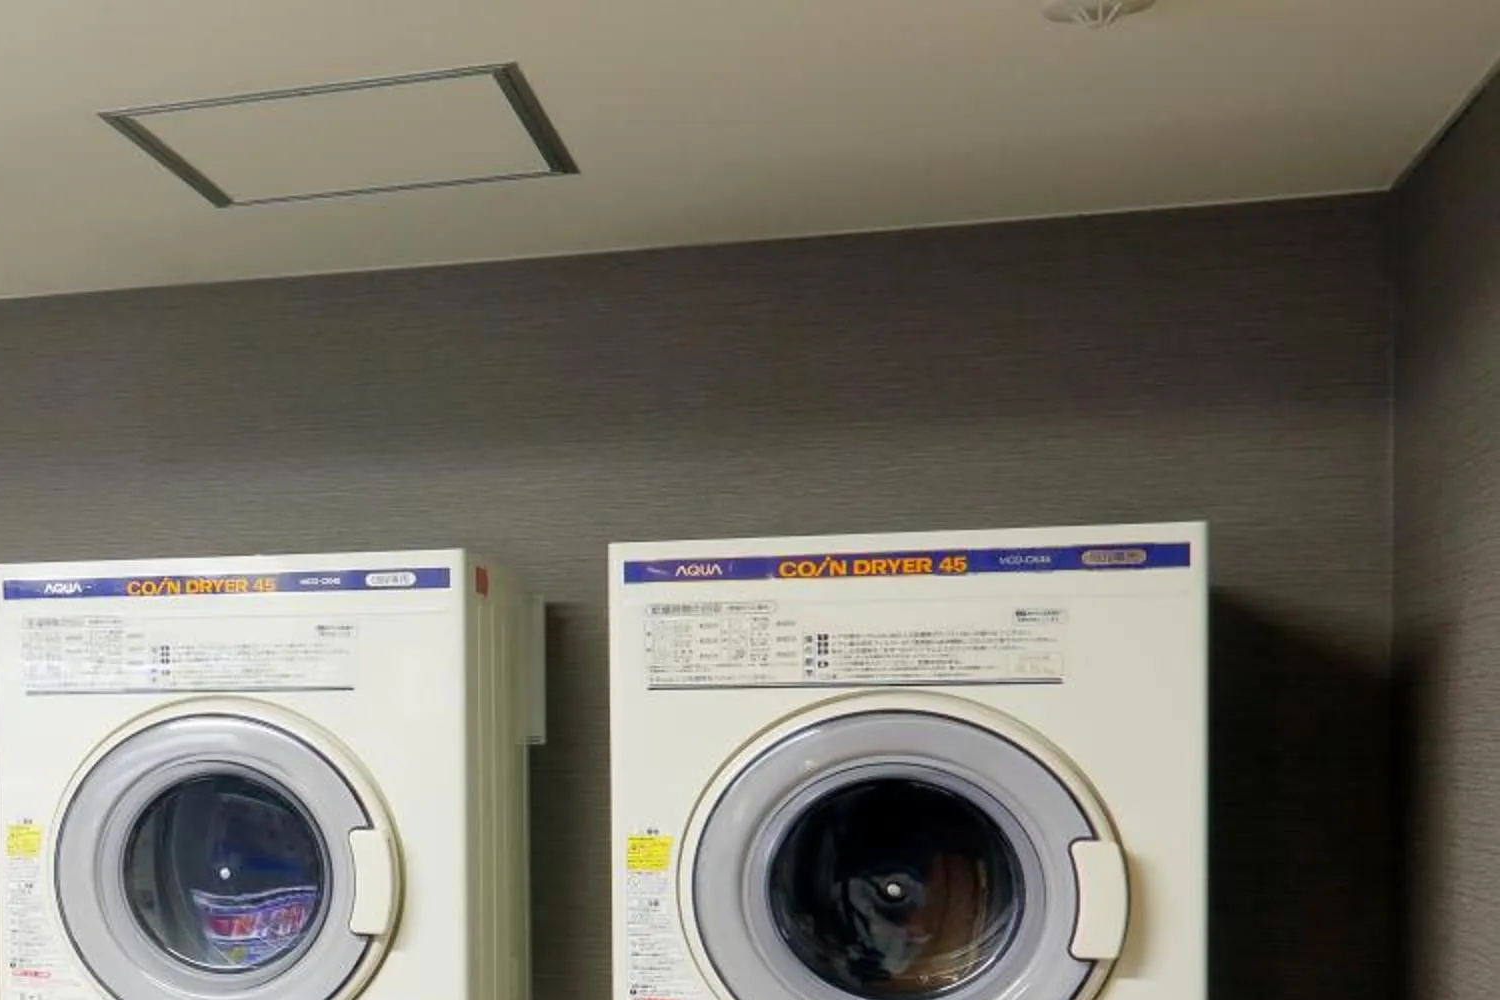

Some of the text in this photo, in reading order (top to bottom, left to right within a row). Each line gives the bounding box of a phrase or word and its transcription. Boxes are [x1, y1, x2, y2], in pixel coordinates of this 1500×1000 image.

[675, 565, 722, 576] AQUA
[853, 558, 932, 575] DRYER
[939, 557, 966, 572] 45
[44, 584, 82, 594] AQUA
[186, 579, 248, 594] DRYER
[252, 577, 276, 592] 45
